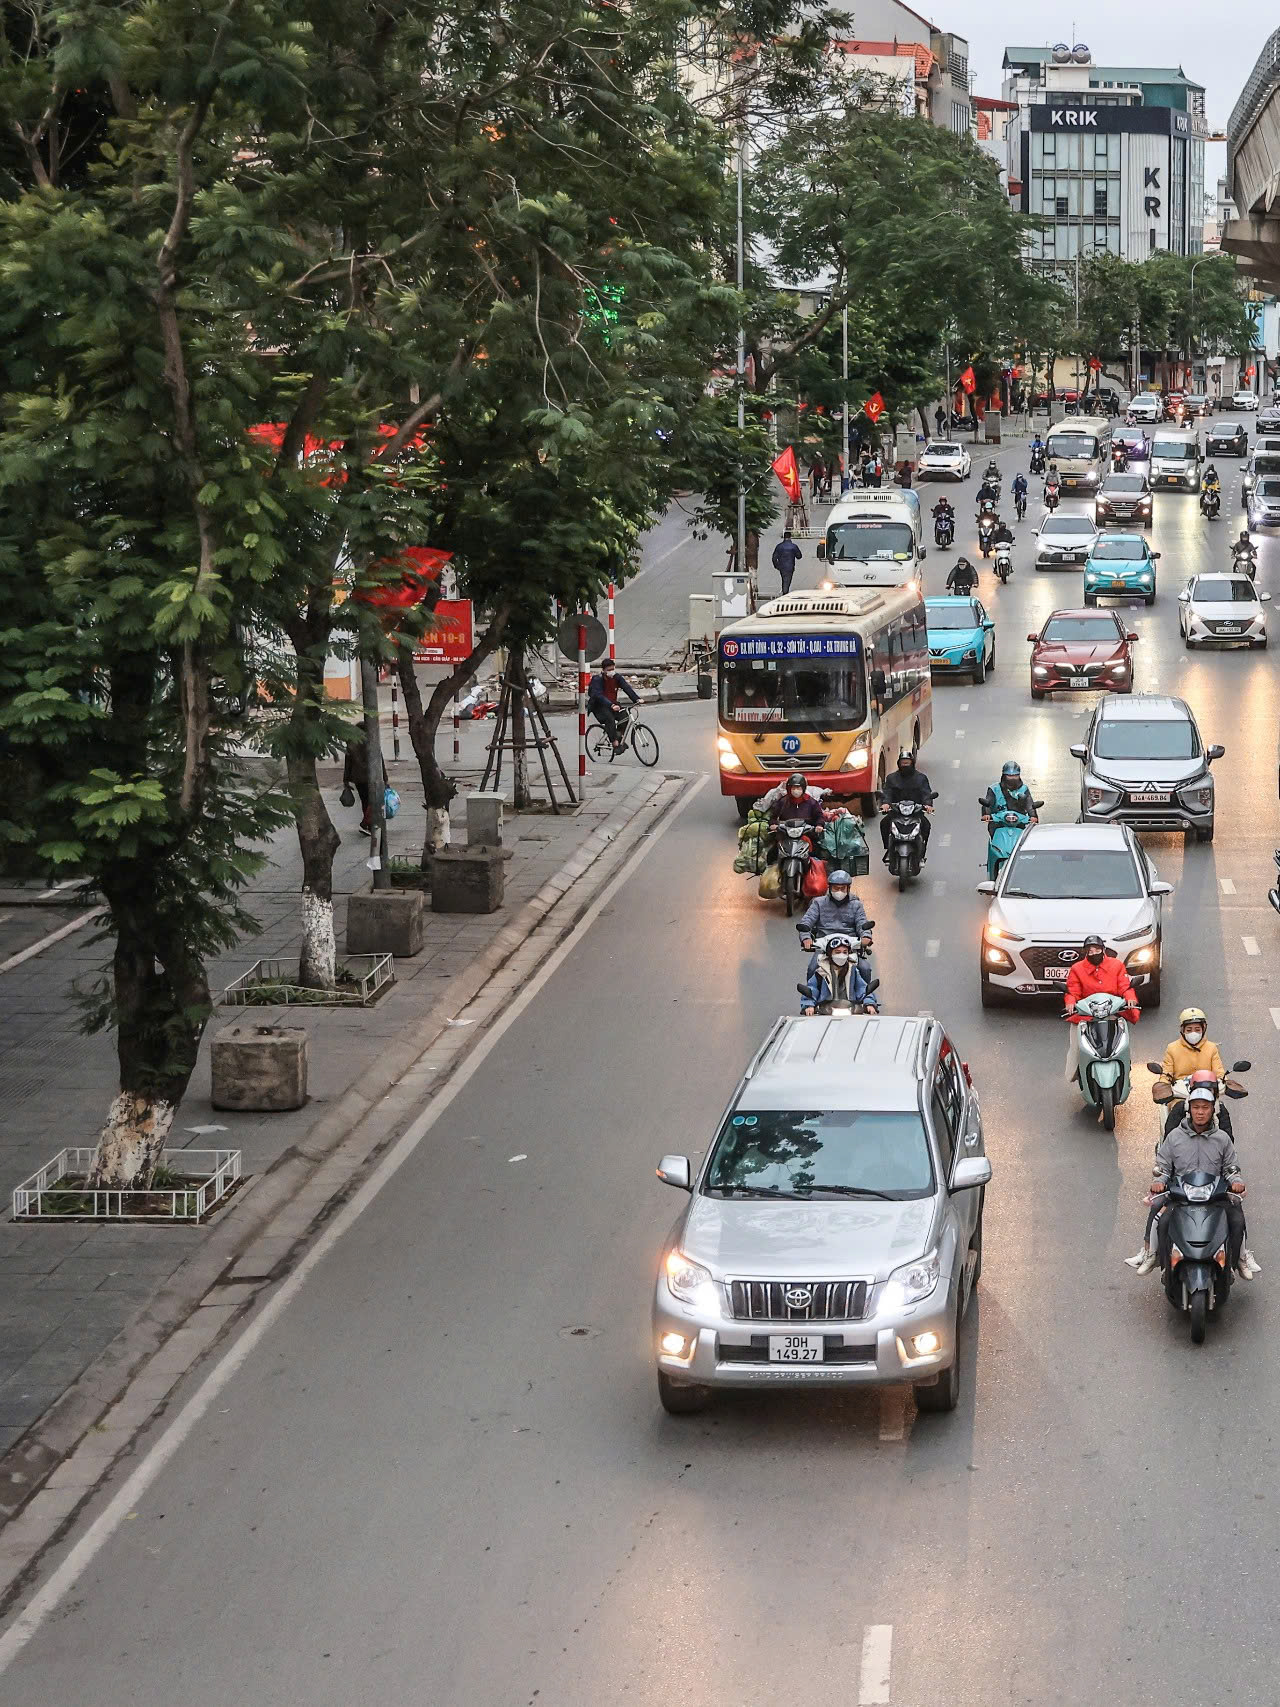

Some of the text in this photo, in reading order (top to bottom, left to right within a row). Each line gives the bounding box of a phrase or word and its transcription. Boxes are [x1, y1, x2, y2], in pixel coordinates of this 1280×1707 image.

[1051, 110, 1098, 126] KRIK
[784, 1337, 808, 1348] 30H
[776, 1348, 818, 1360] 149.27
